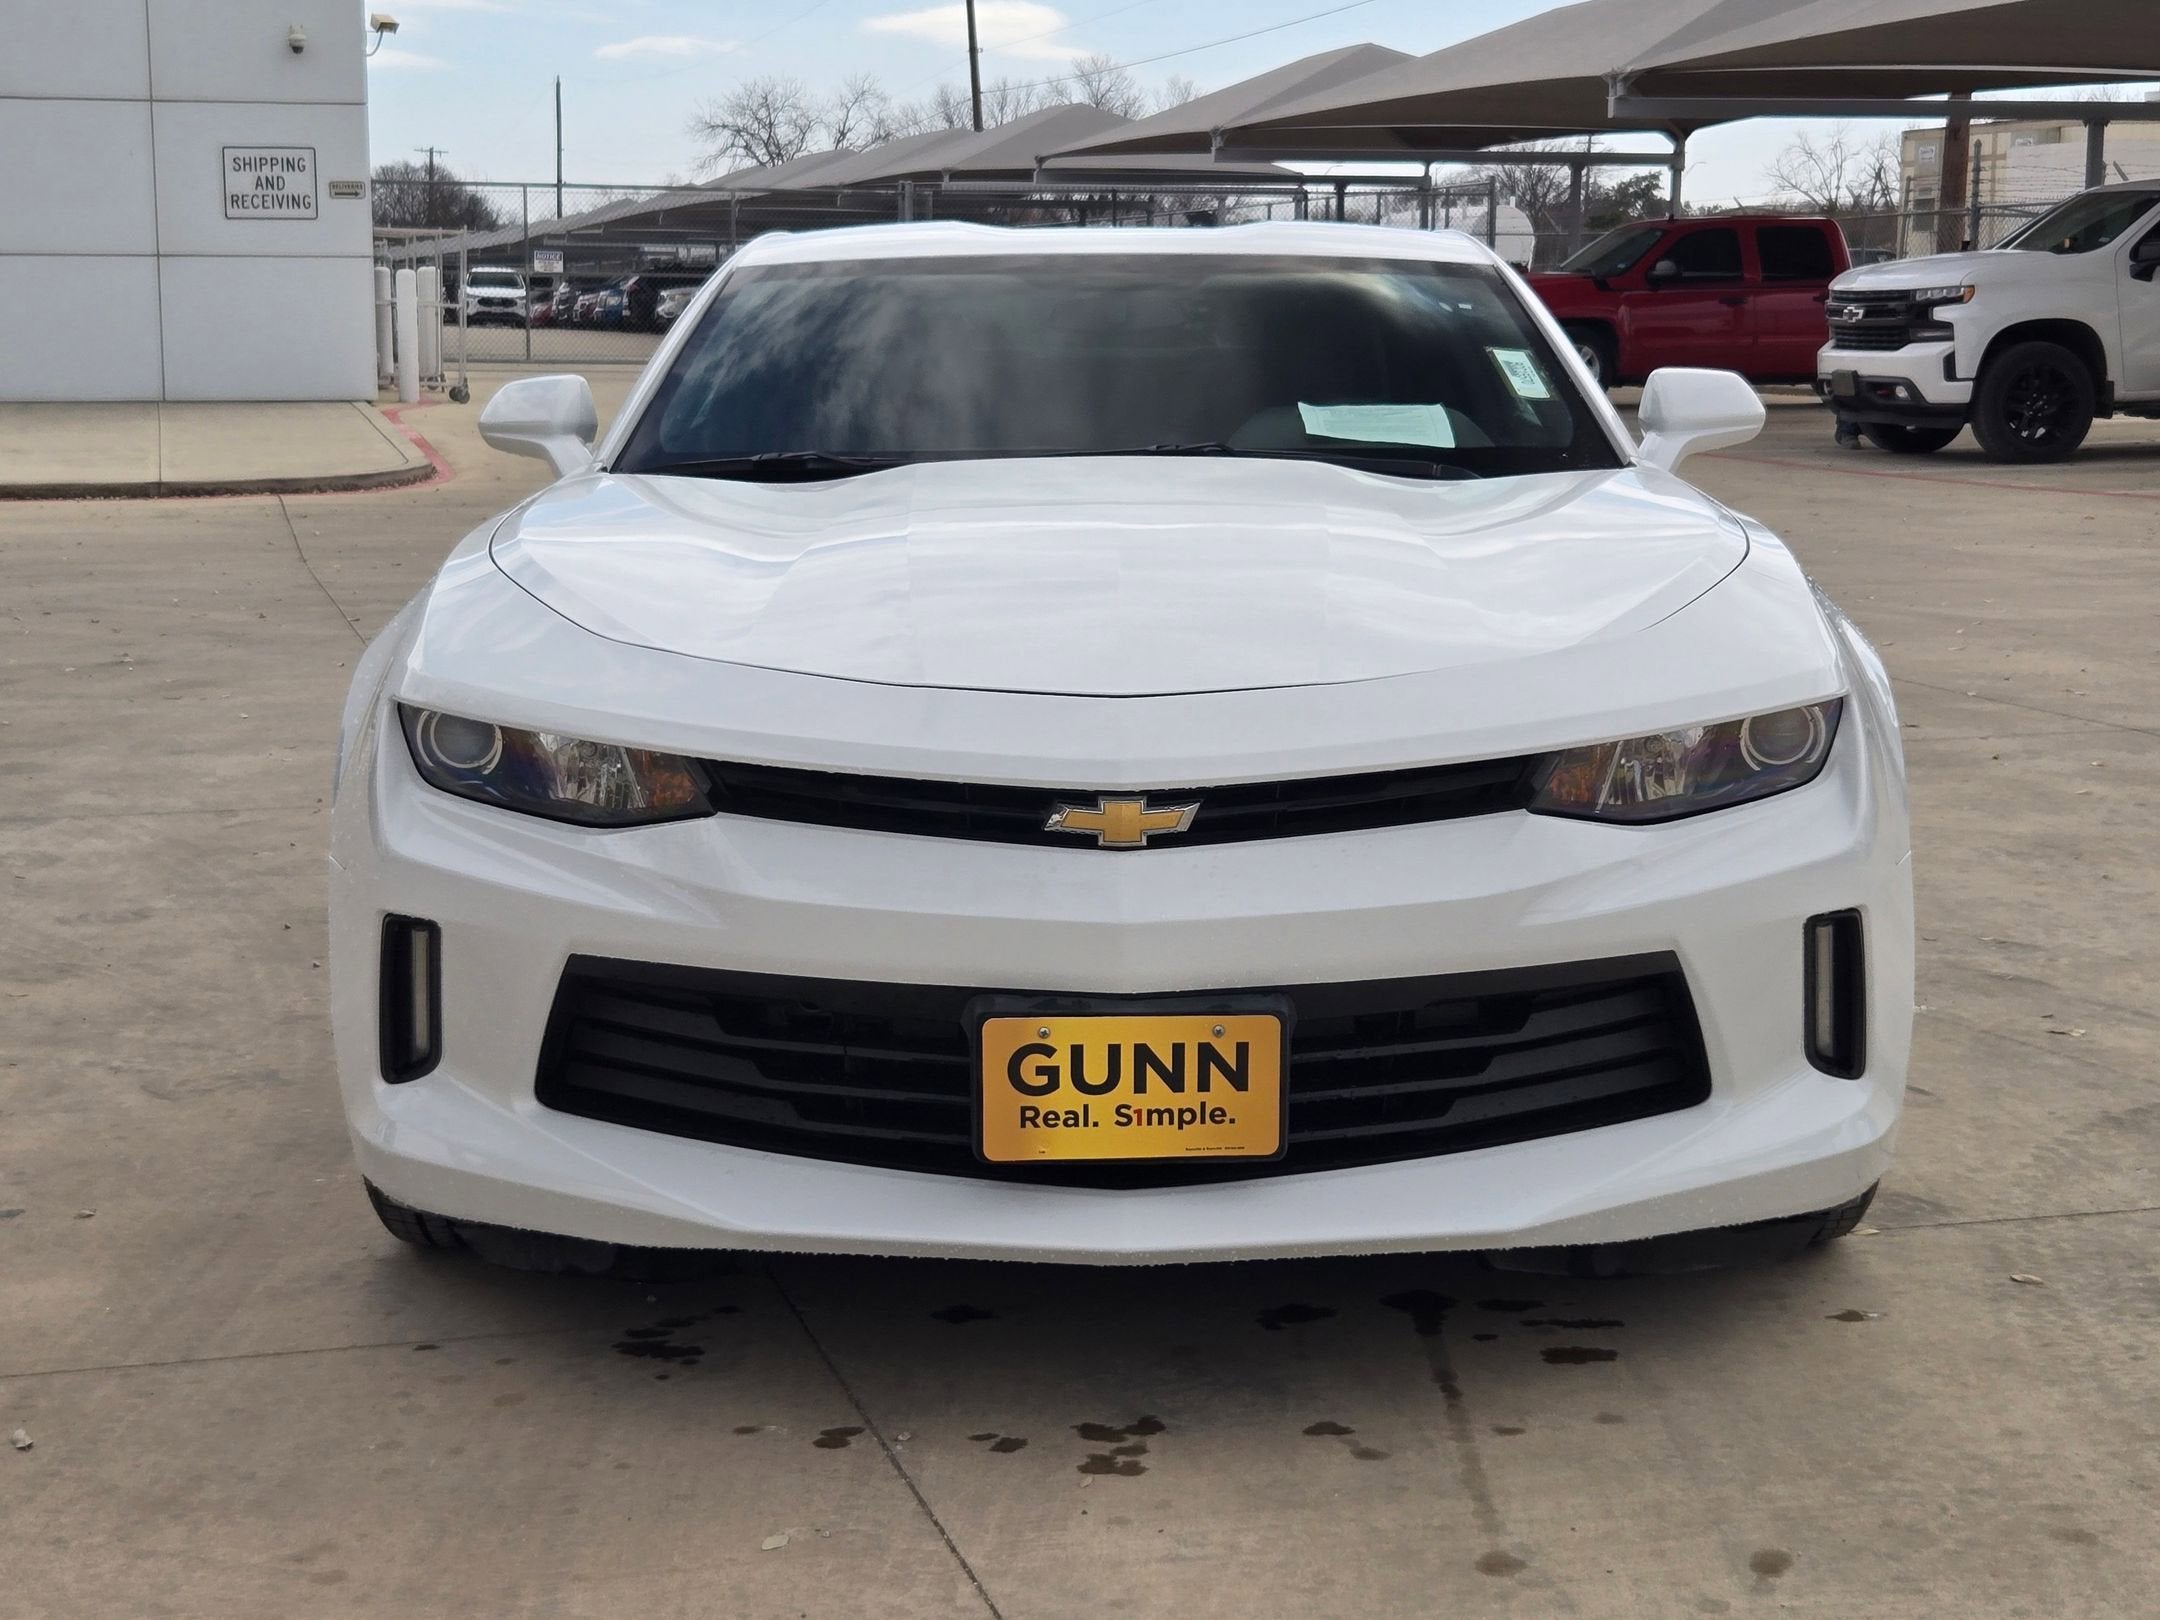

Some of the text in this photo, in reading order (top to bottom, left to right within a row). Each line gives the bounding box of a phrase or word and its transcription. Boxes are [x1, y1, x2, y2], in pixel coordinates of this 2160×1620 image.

[232, 156, 306, 172] SHIPPING
[254, 175, 286, 191] AND
[230, 193, 311, 210] RECEIVING
[1007, 1041, 1250, 1097] GUNN
[1020, 1104, 1099, 1129] Real.
